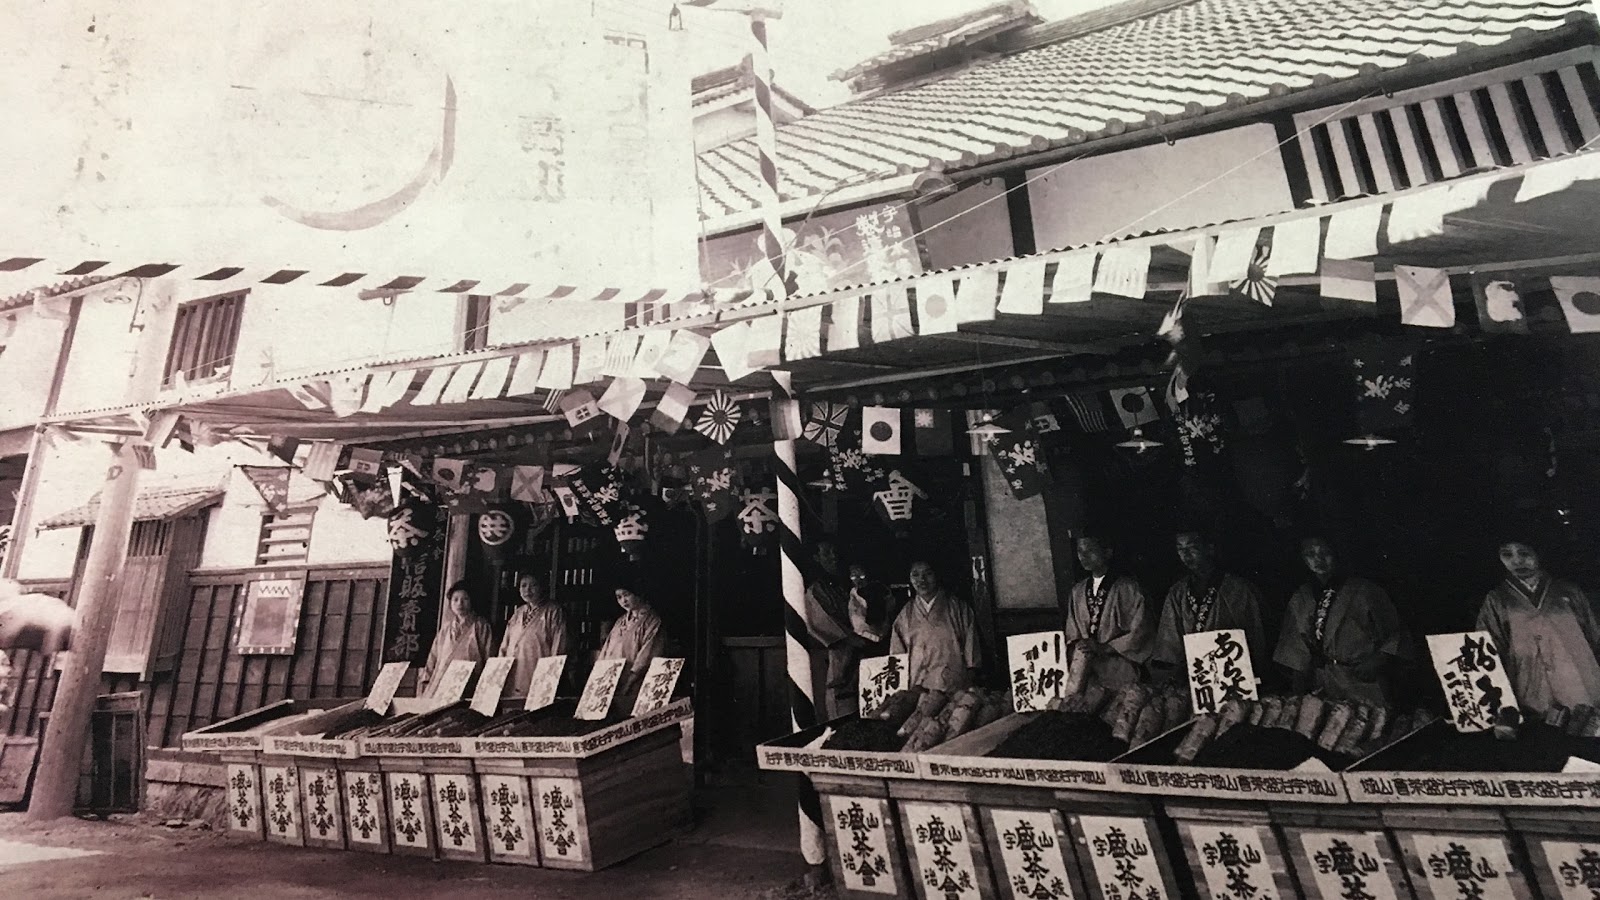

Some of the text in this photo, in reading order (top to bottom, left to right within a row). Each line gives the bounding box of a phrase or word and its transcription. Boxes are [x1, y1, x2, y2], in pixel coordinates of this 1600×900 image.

[737, 487, 779, 534] 茶
[873, 470, 928, 520] 會
[390, 508, 428, 548] 茶
[883, 656, 904, 698] 青
[1034, 634, 1064, 698] 川柳
